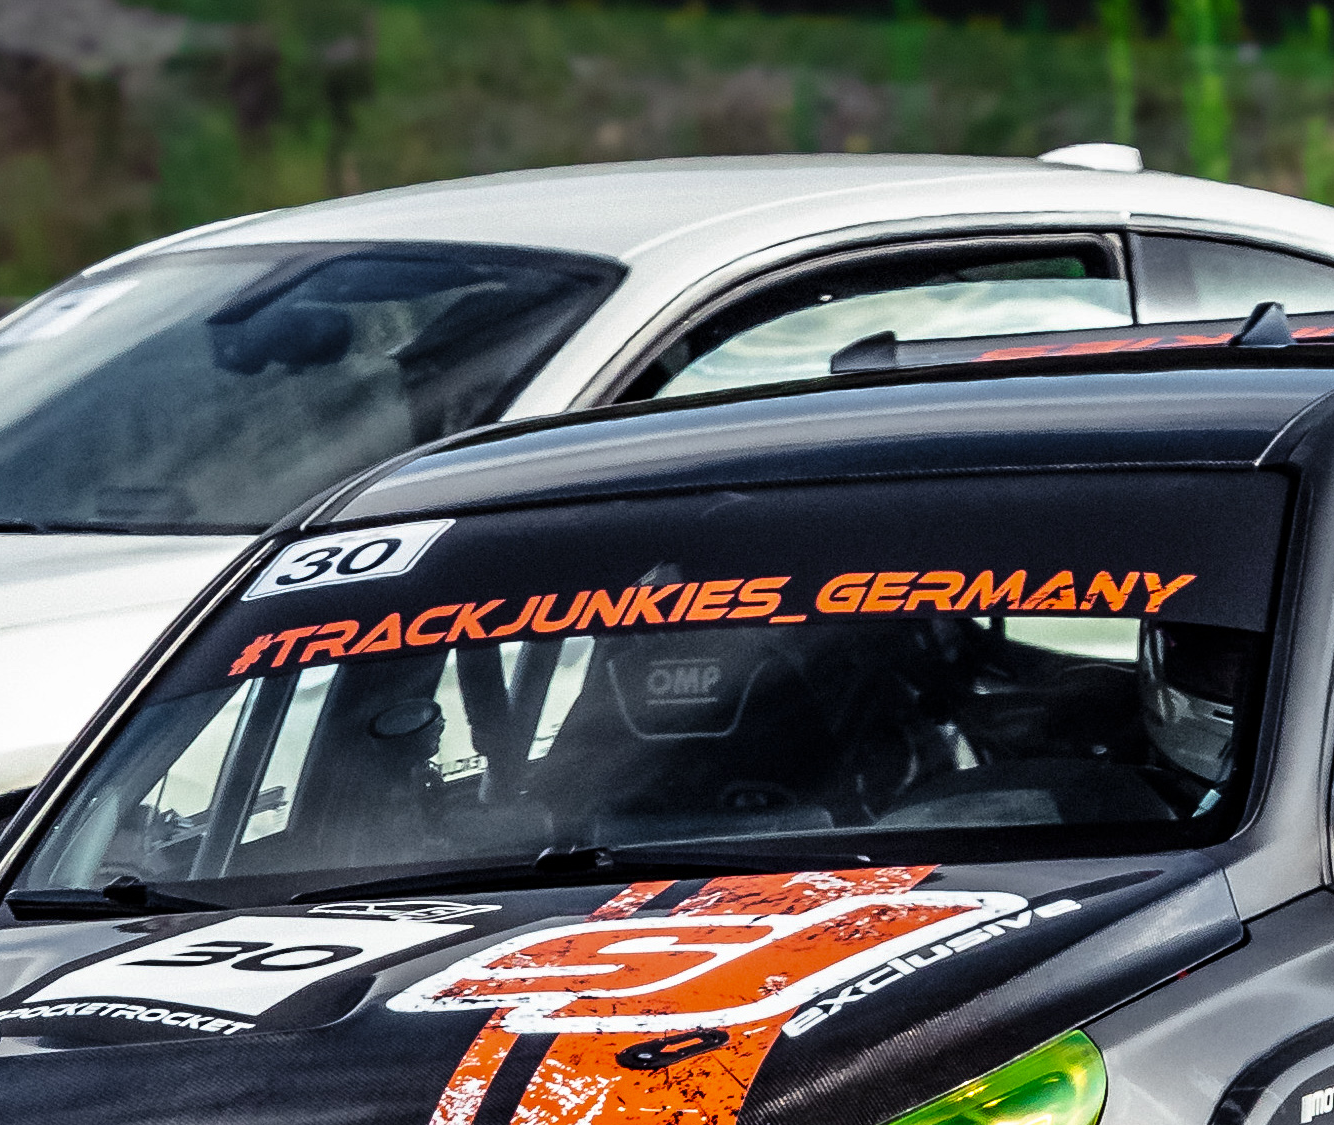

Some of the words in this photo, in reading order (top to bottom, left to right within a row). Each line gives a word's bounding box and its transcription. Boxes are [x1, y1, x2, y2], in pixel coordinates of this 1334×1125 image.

[276, 538, 402, 586] 30
[228, 569, 1197, 676] #TRACKJUNKIES_GERMANY
[647, 665, 721, 695] OMP
[121, 941, 365, 971] 30
[782, 899, 1082, 1038] exclusive
